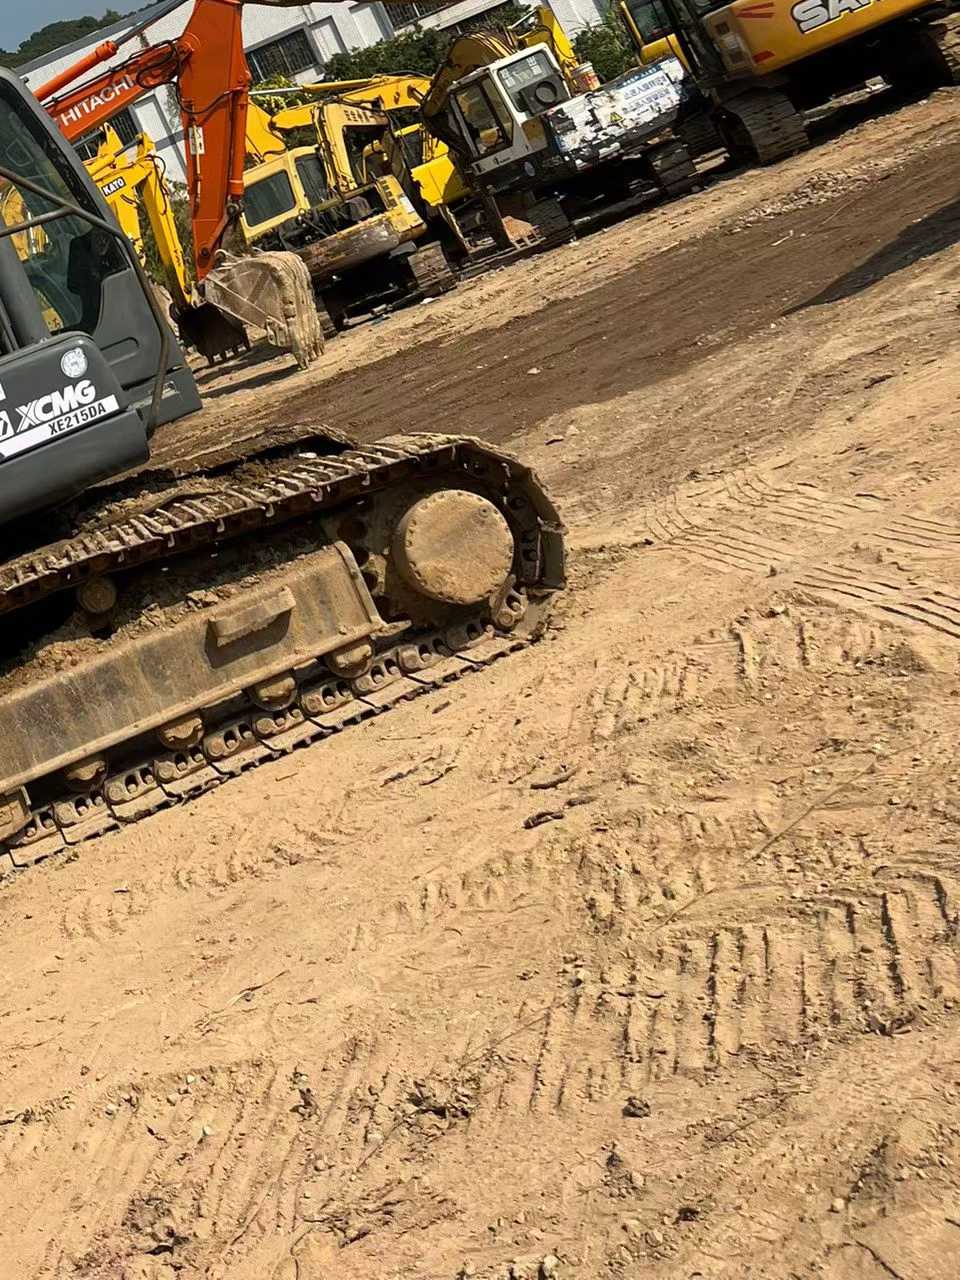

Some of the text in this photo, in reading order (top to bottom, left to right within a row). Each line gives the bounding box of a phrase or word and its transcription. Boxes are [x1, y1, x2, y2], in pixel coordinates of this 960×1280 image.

[61, 75, 134, 126] HITACHI
[102, 178, 125, 195] KATO
[16, 380, 96, 433] XCMG
[48, 402, 107, 436] XE215DA
